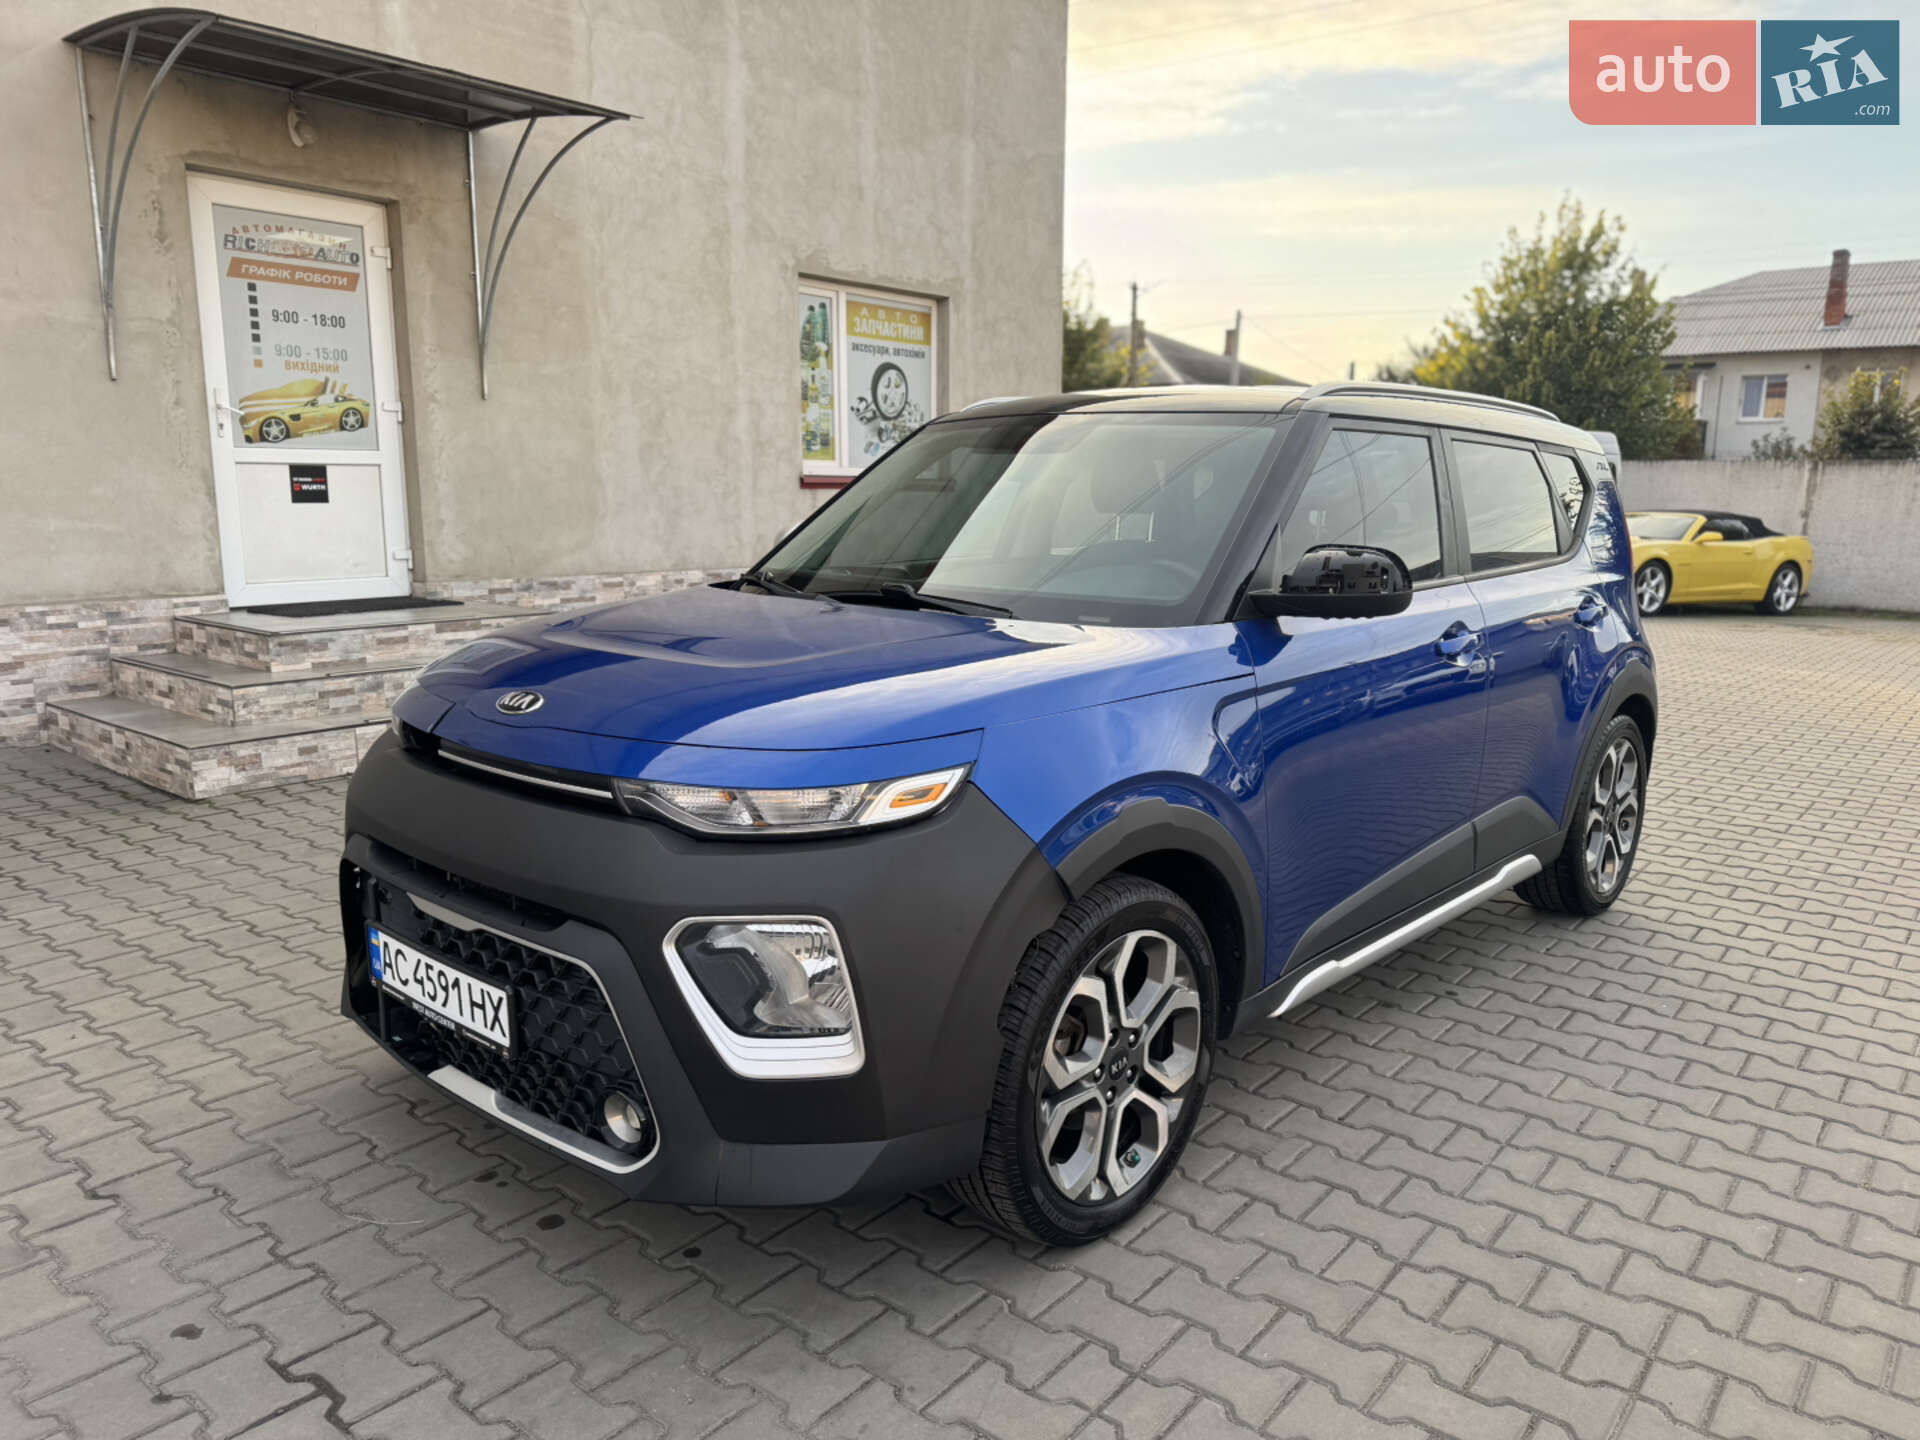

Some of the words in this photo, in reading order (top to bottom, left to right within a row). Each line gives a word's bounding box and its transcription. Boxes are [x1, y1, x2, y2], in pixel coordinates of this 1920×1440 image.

[241, 264, 292, 280] ГРАФІК
[294, 270, 349, 286] РОБОТИ
[271, 309, 300, 324] 9:00
[311, 313, 346, 329] 18:00
[274, 343, 302, 358] 9:00
[314, 347, 348, 362] 15:00
[383, 941, 410, 987] AC
[413, 958, 464, 1017] 4591
[468, 982, 507, 1038] HX
